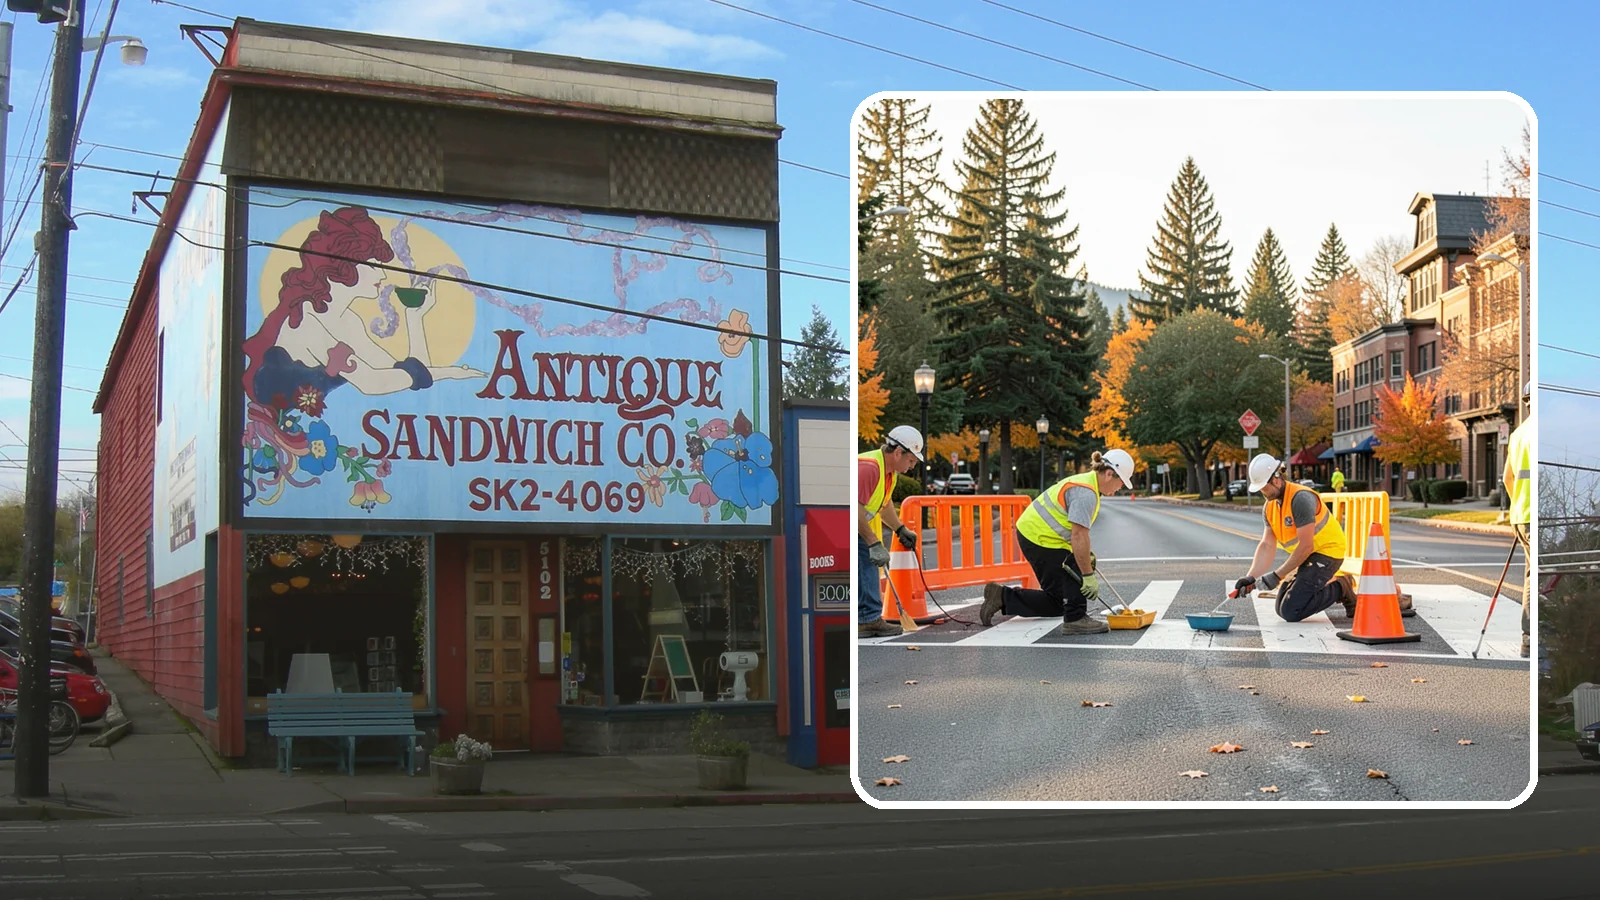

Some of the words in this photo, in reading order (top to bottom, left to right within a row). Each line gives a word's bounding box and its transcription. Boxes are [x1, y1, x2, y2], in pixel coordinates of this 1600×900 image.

[476, 328, 725, 421] ANTIQUE
[361, 408, 606, 468] SANDWICH
[617, 420, 685, 470] CO.
[468, 477, 646, 514] SK2-4069
[539, 541, 552, 600] 5102
[809, 555, 835, 569] BOOKS
